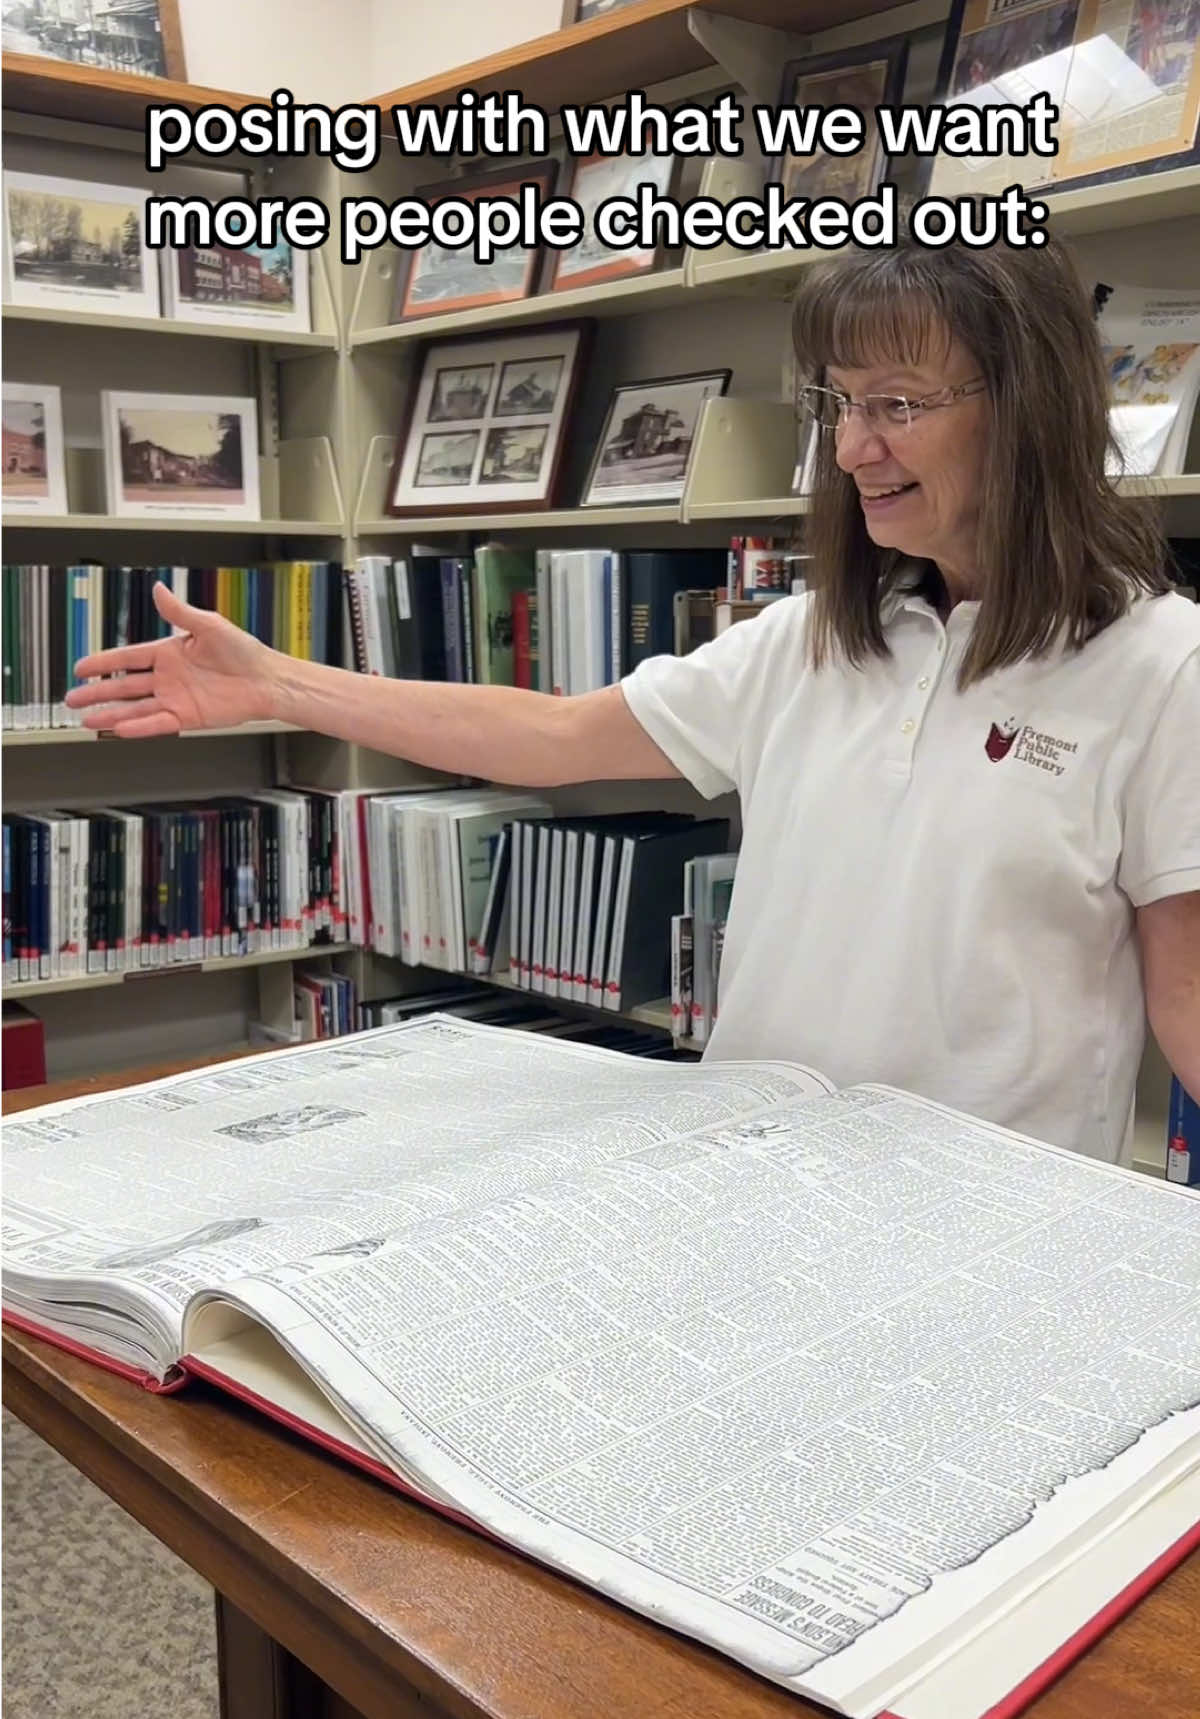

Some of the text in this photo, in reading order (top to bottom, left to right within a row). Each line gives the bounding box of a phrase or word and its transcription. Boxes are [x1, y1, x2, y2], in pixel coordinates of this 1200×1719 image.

[1017, 737, 1060, 760] Public
[1022, 726, 1079, 754] Fremont
[1014, 749, 1065, 776] Library
[748, 1574, 815, 1610] CONGRESS
[733, 1590, 796, 1623] MESSAGE
[806, 1603, 829, 1619] TO
[825, 1612, 865, 1636] READ
